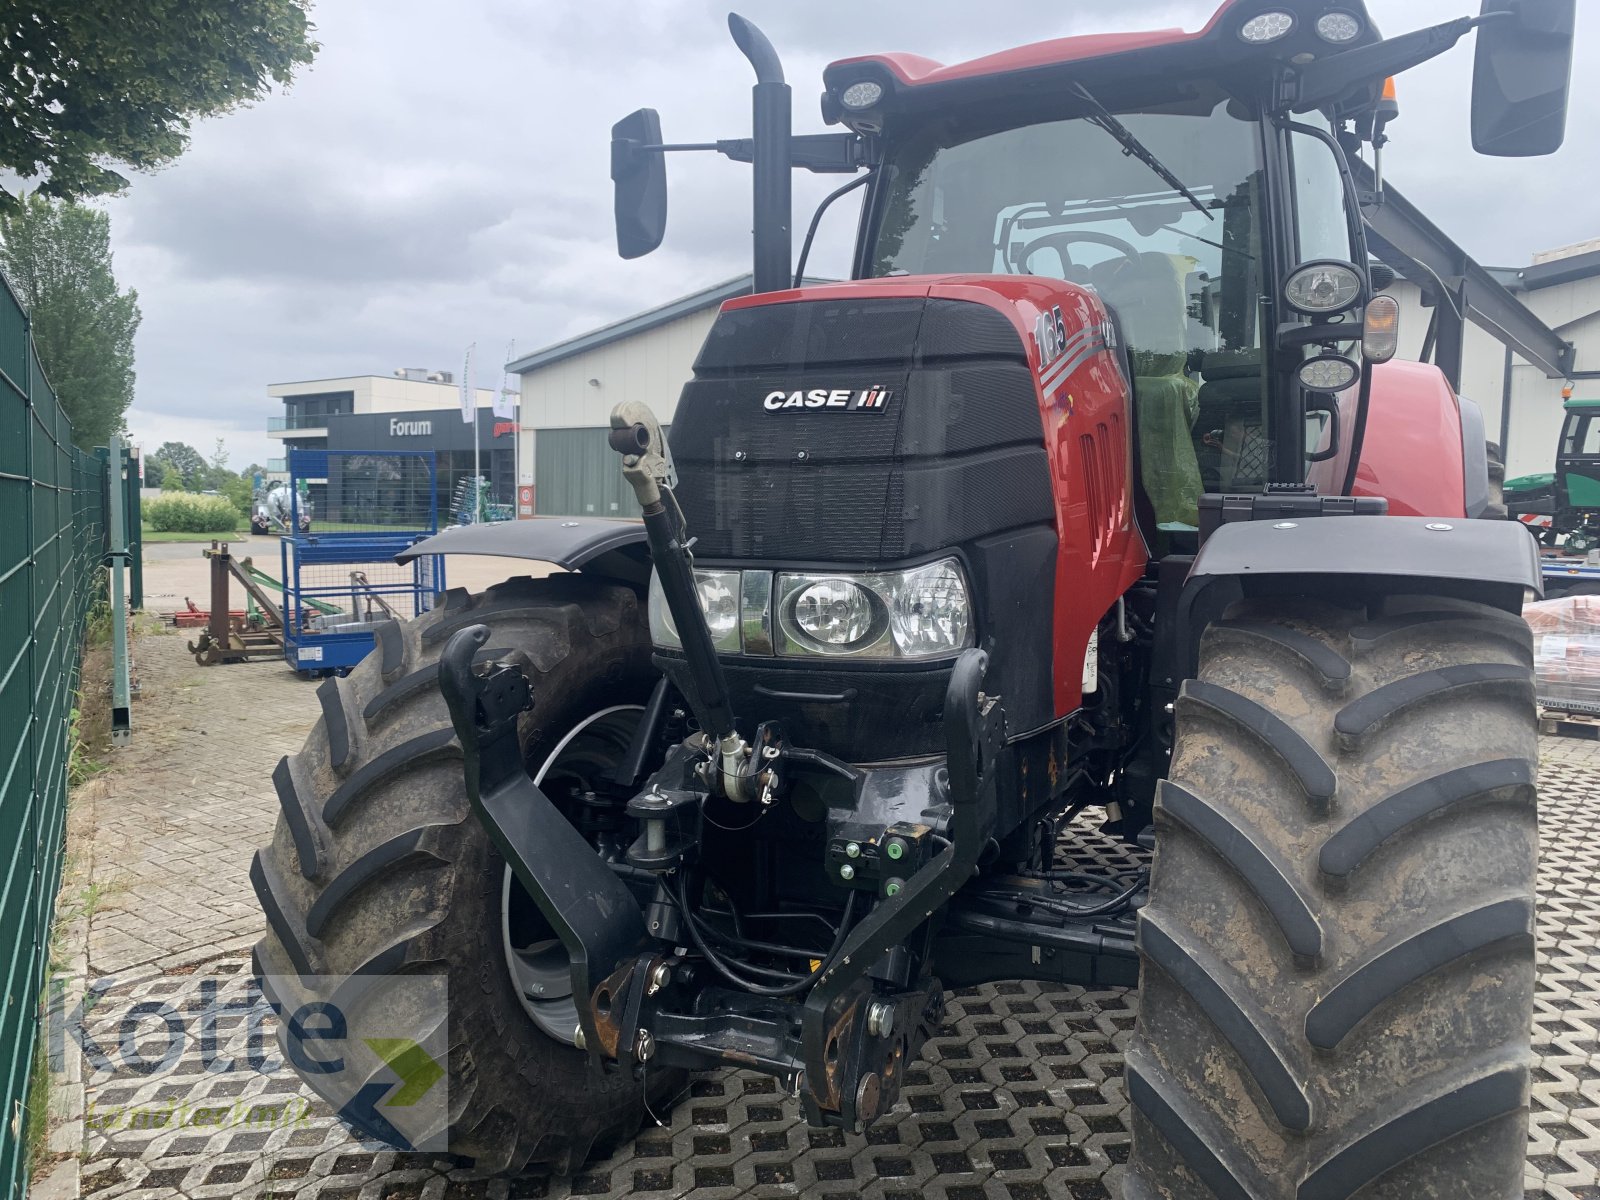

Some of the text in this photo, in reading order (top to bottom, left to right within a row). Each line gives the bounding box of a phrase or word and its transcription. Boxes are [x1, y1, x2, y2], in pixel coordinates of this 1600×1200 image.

[1034, 304, 1066, 373] 165
[763, 389, 851, 410] CASE
[390, 418, 432, 436] Forum
